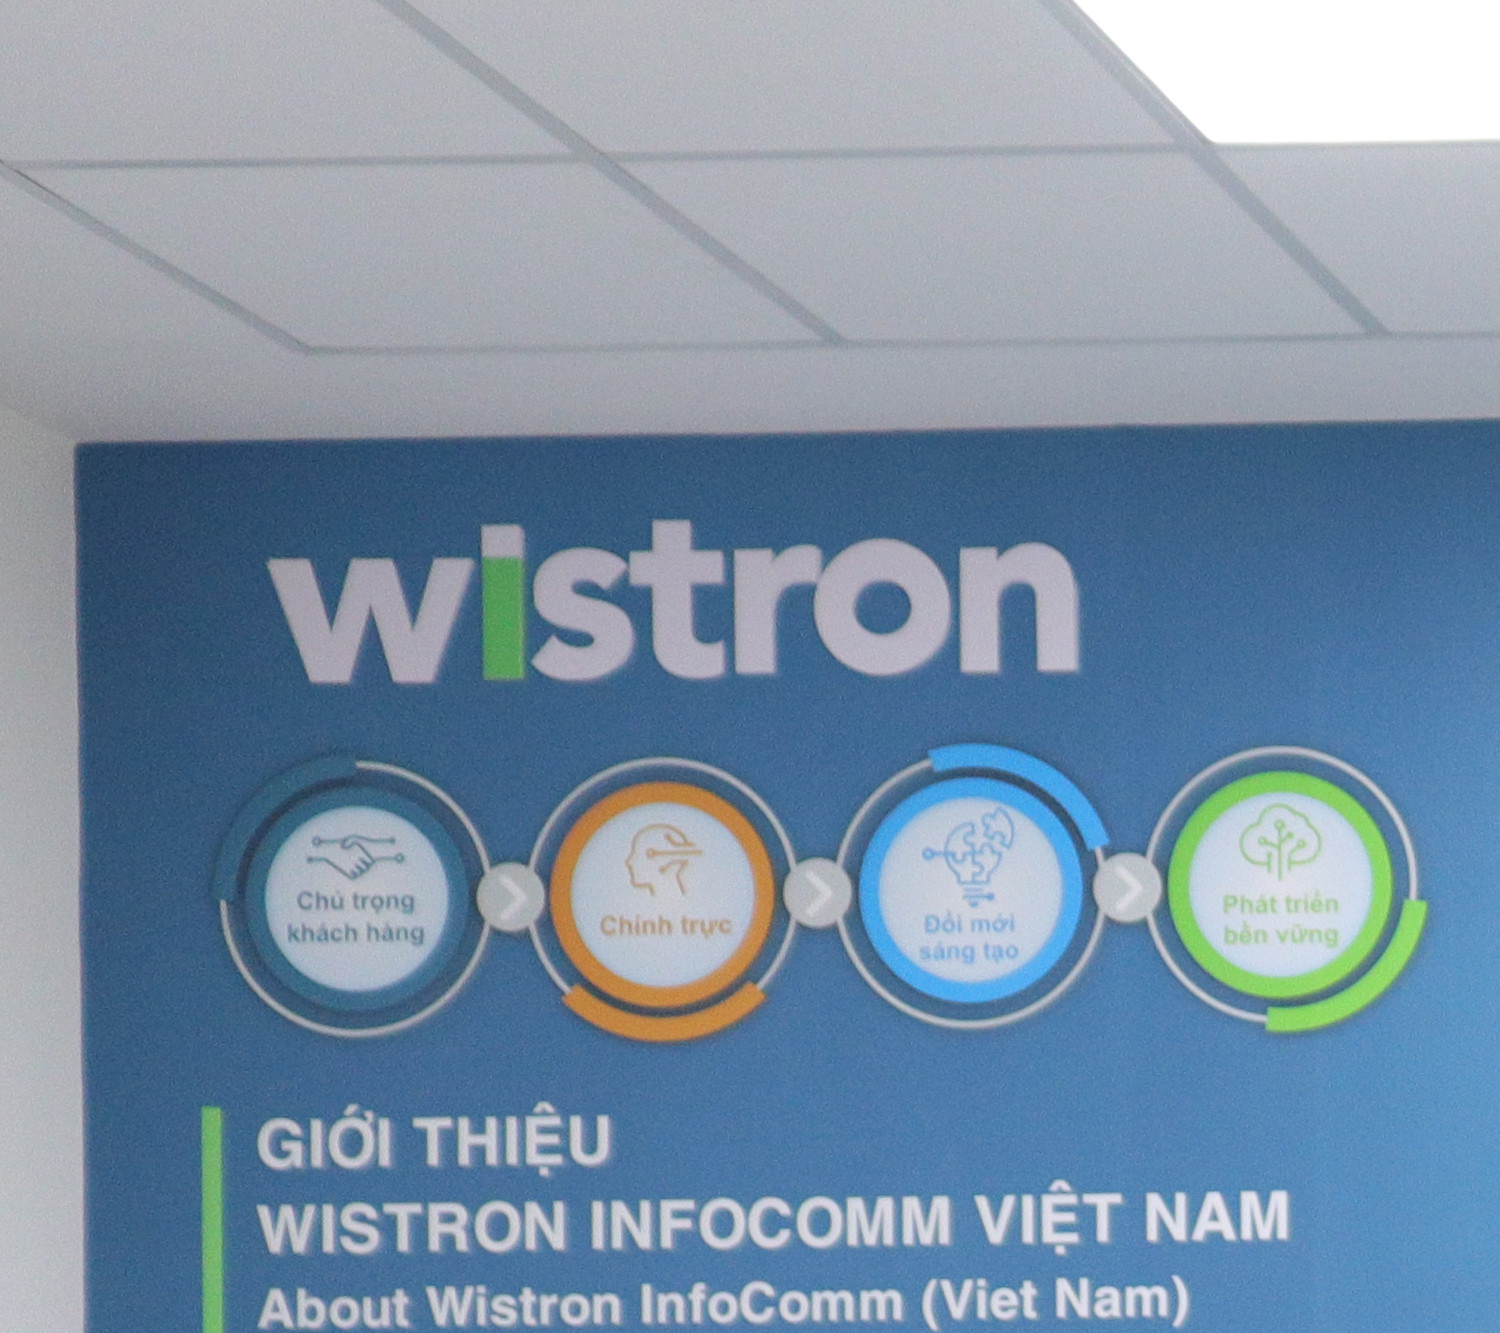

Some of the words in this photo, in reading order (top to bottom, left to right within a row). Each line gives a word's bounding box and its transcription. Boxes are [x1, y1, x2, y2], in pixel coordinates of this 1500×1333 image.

[266, 519, 1082, 684] wistron
[257, 1103, 391, 1171] GIỚI
[412, 1101, 611, 1177] THIỆU
[256, 1200, 566, 1255] WISTRON
[592, 1195, 951, 1251] INFOCOMM
[974, 1179, 1123, 1256] VIỆT
[1145, 1190, 1289, 1243] NAM
[257, 1287, 410, 1330] About
[425, 1285, 622, 1327] Wistron
[641, 1280, 903, 1325] InfoComm
[922, 1278, 1038, 1332] (Viet
[1055, 1274, 1190, 1328] Nam)
